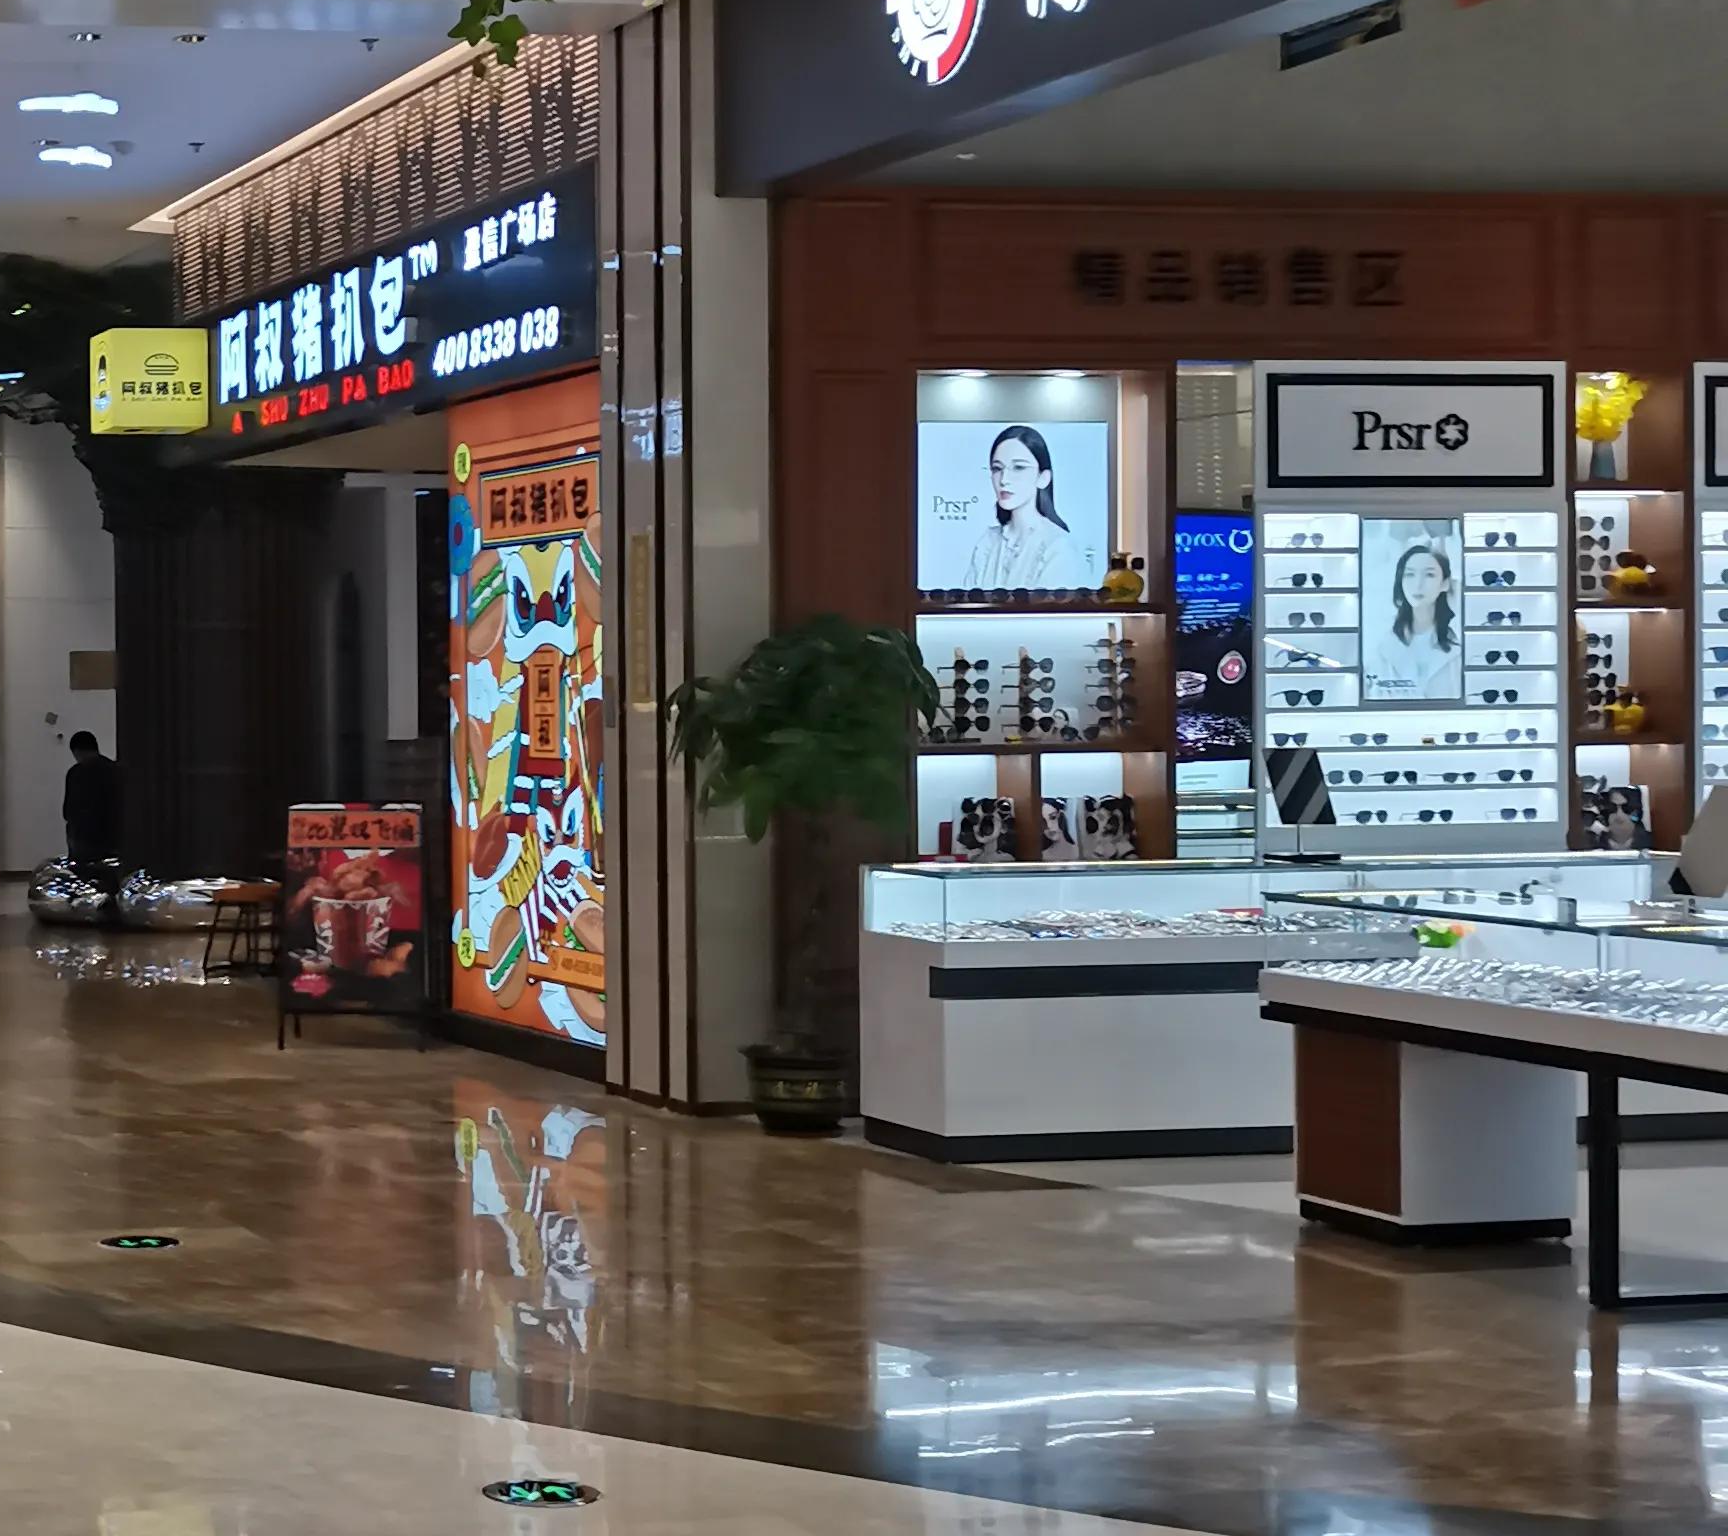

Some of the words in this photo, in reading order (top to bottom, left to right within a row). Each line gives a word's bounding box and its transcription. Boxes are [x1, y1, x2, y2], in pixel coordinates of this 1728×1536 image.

[231, 411, 244, 436] A
[341, 374, 368, 406] PA
[376, 359, 415, 396] BAO
